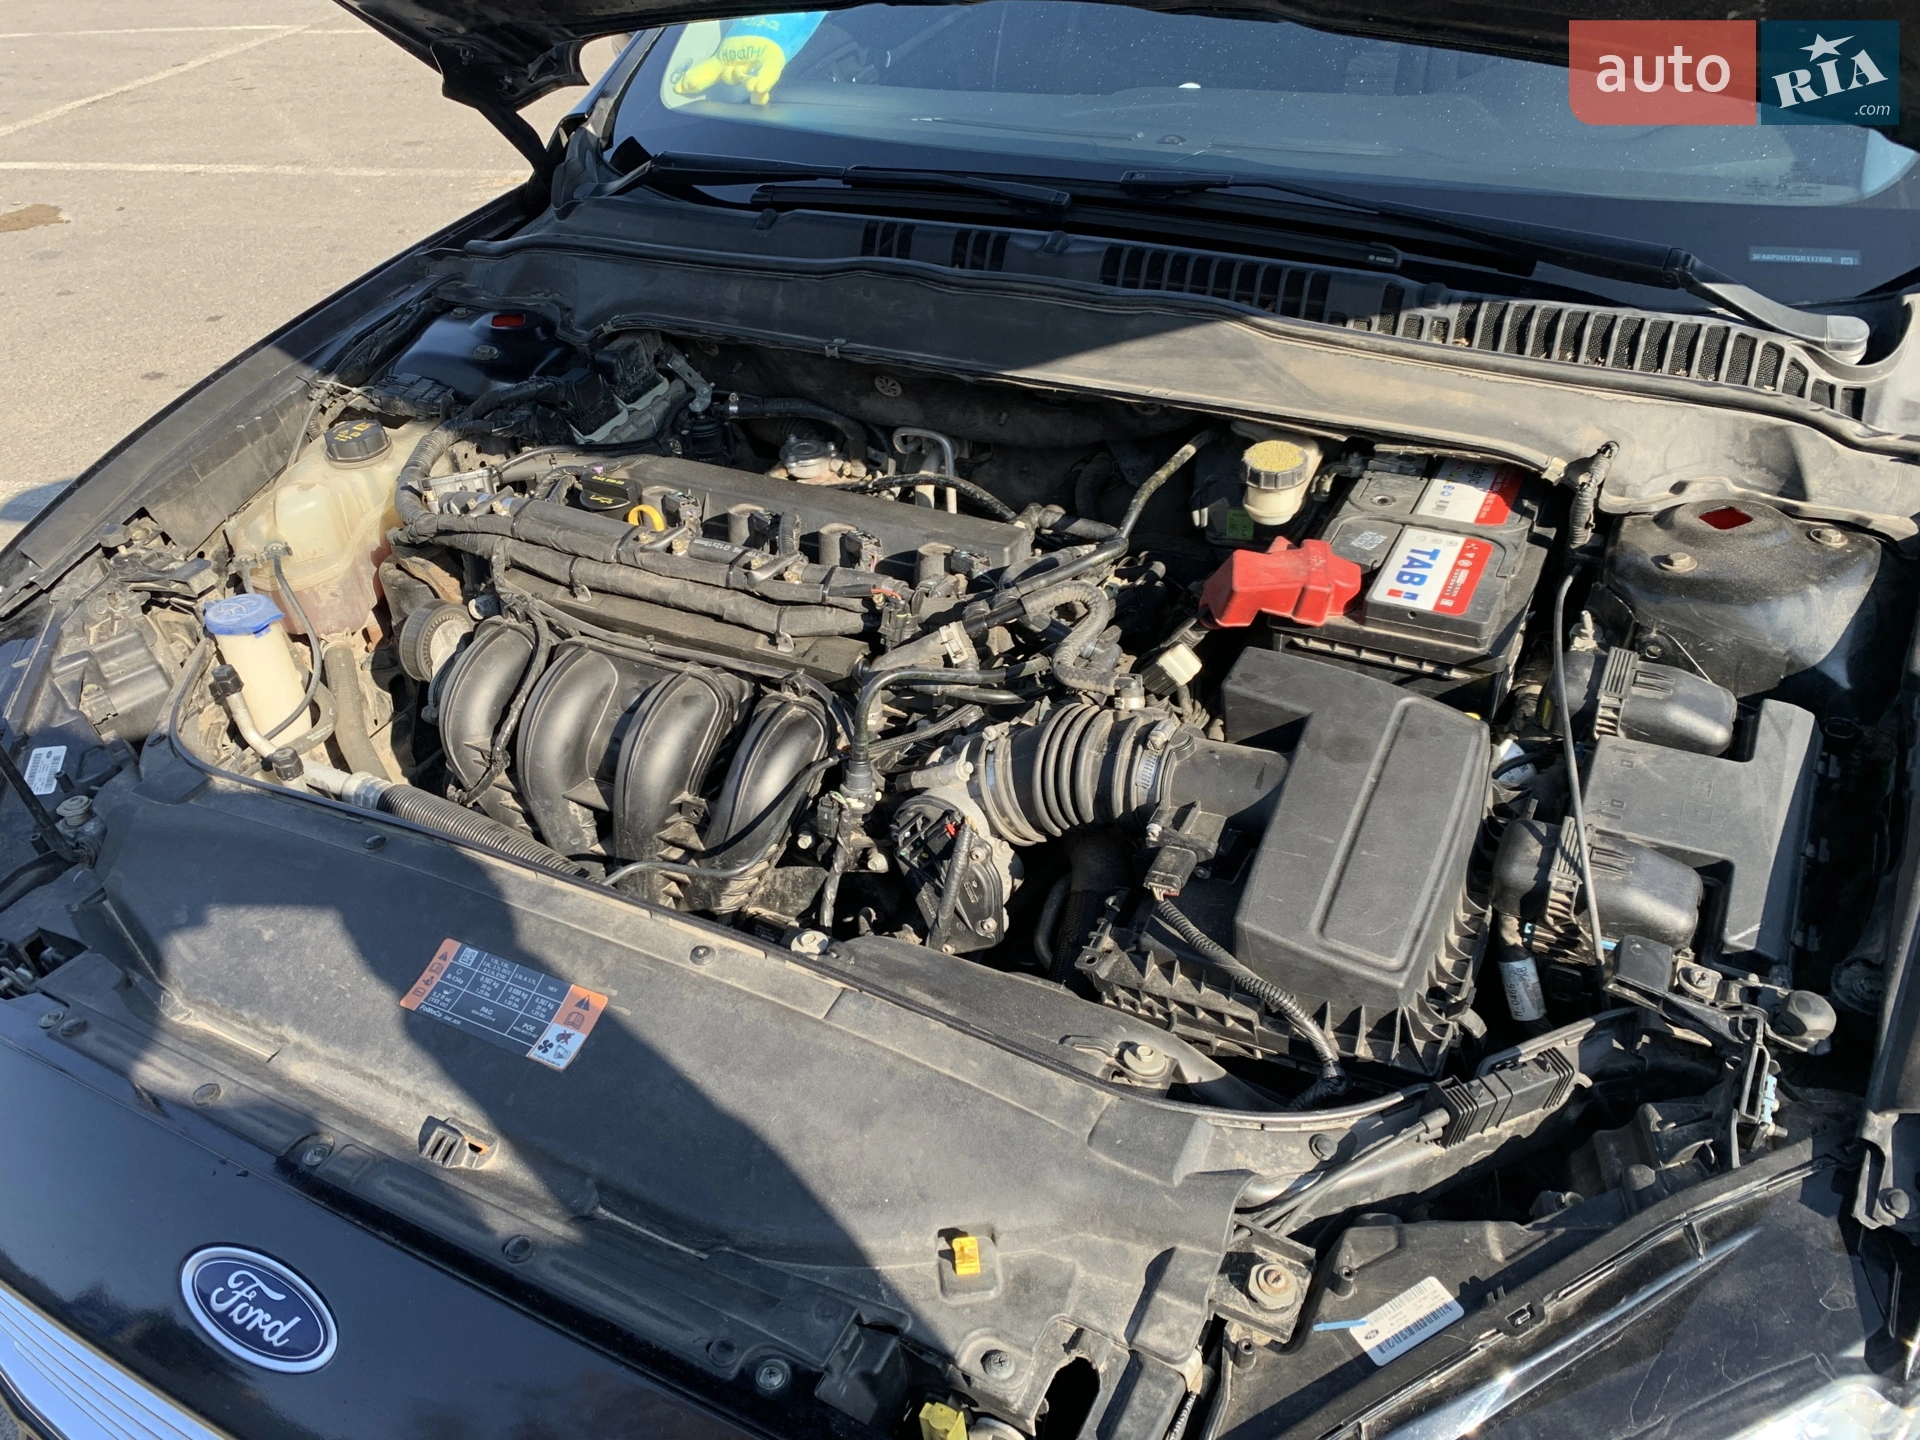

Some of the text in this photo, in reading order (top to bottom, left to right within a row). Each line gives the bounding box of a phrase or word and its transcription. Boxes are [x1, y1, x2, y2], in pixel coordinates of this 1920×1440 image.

[1395, 548, 1441, 587] TAB
[444, 973, 465, 984] R-134a
[418, 1004, 443, 1017] FoMoCo
[479, 1006, 494, 1015] PAG
[521, 1022, 536, 1032] POE
[210, 1270, 301, 1347] Ford
